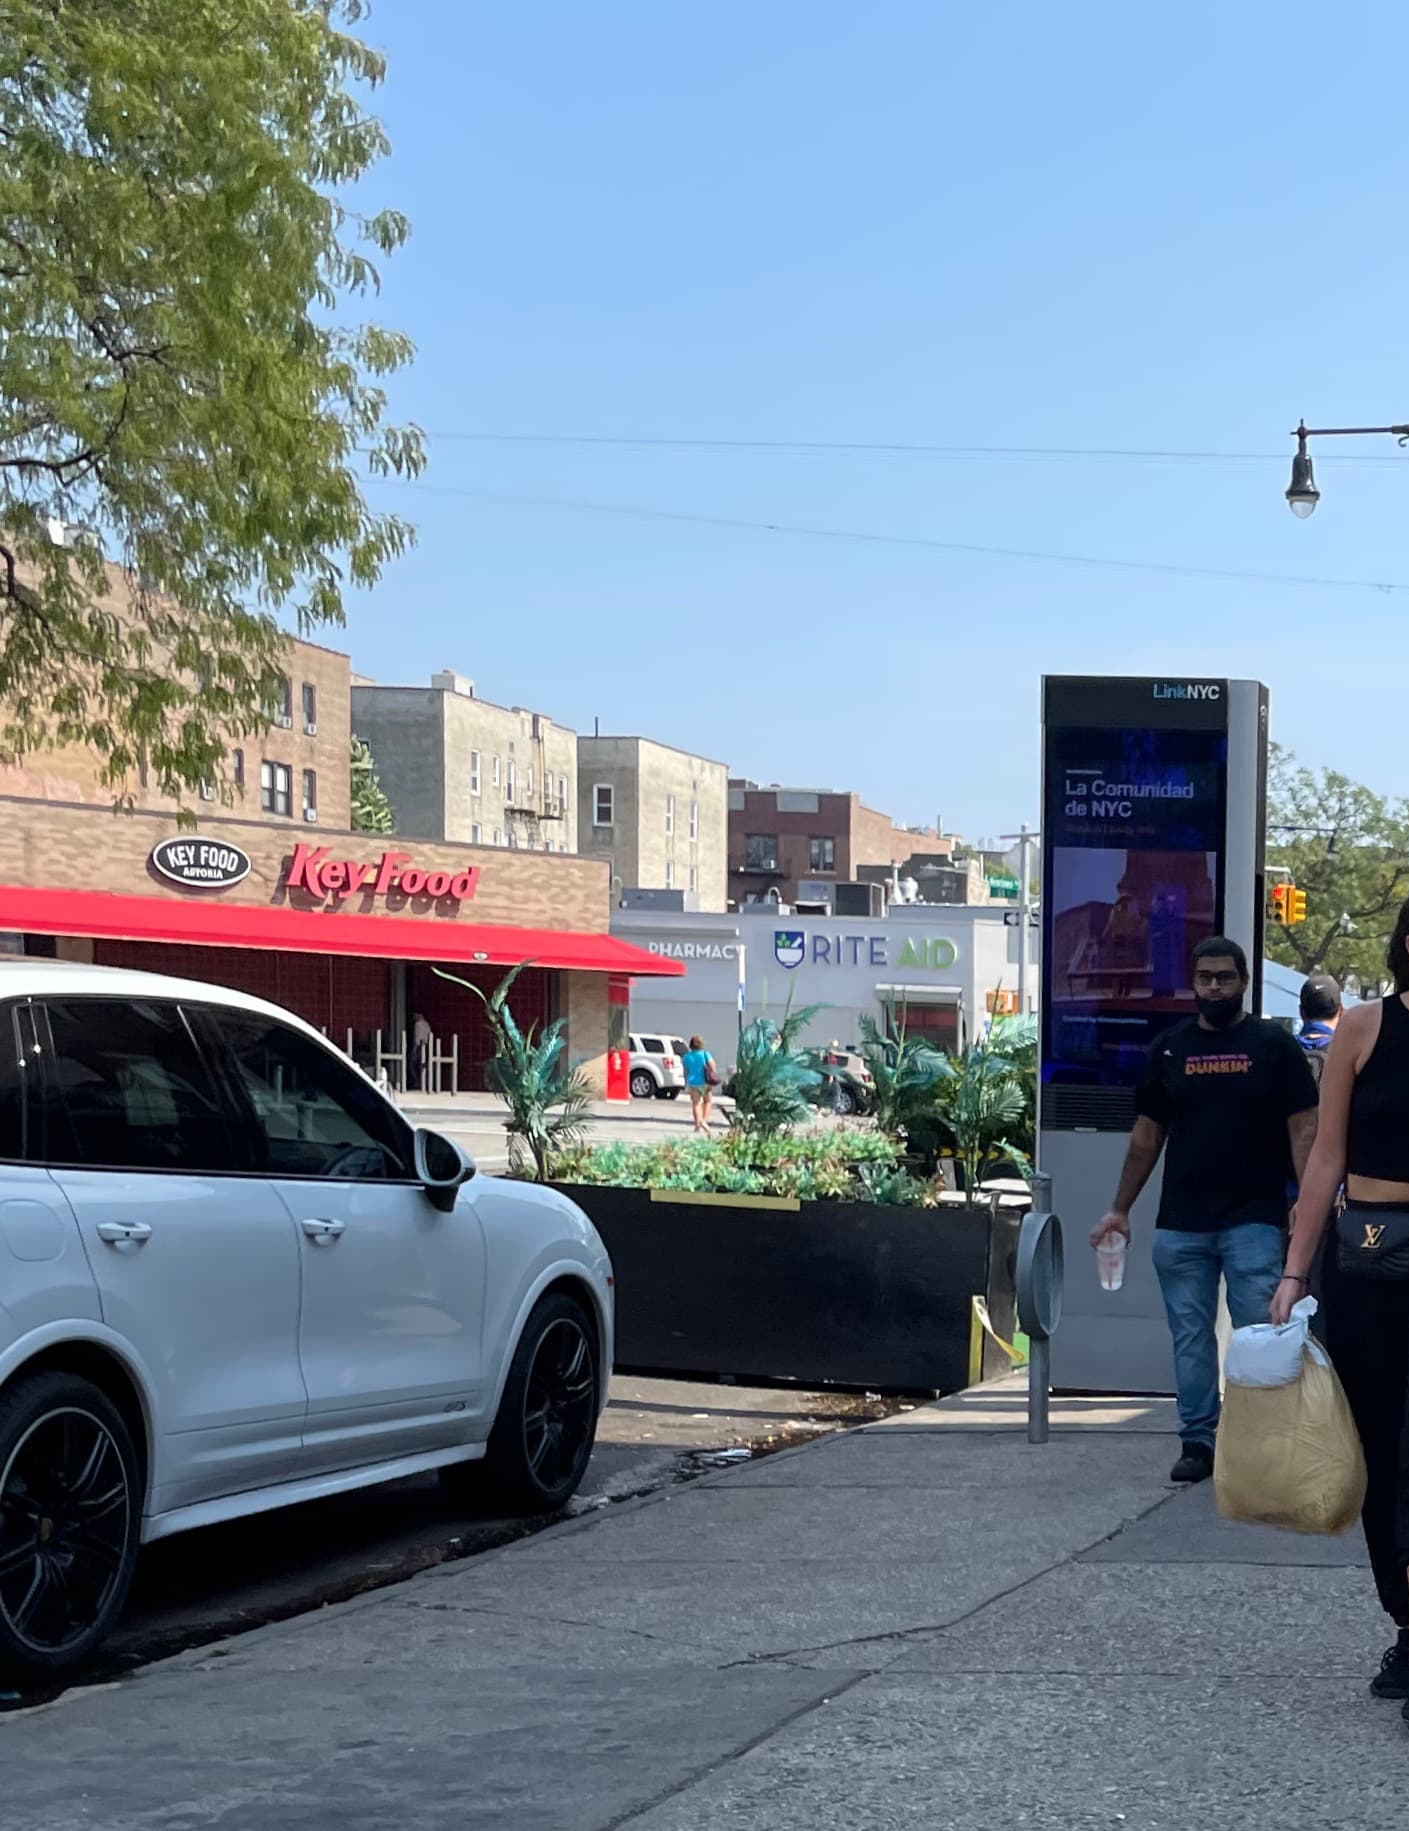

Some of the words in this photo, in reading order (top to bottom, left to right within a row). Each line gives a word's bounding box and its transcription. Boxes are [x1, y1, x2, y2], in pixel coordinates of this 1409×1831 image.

[1153, 684, 1220, 700] LinkNYC
[1065, 780, 1088, 796] La
[1091, 780, 1194, 799] Comunidad
[1065, 800, 1088, 817] de
[1092, 801, 1132, 818] NYC
[166, 845, 195, 868] KEY
[200, 845, 239, 872] FOOD
[287, 843, 373, 899] Key
[374, 852, 481, 900] Food
[812, 935, 888, 966] RITE
[898, 936, 957, 969] AID
